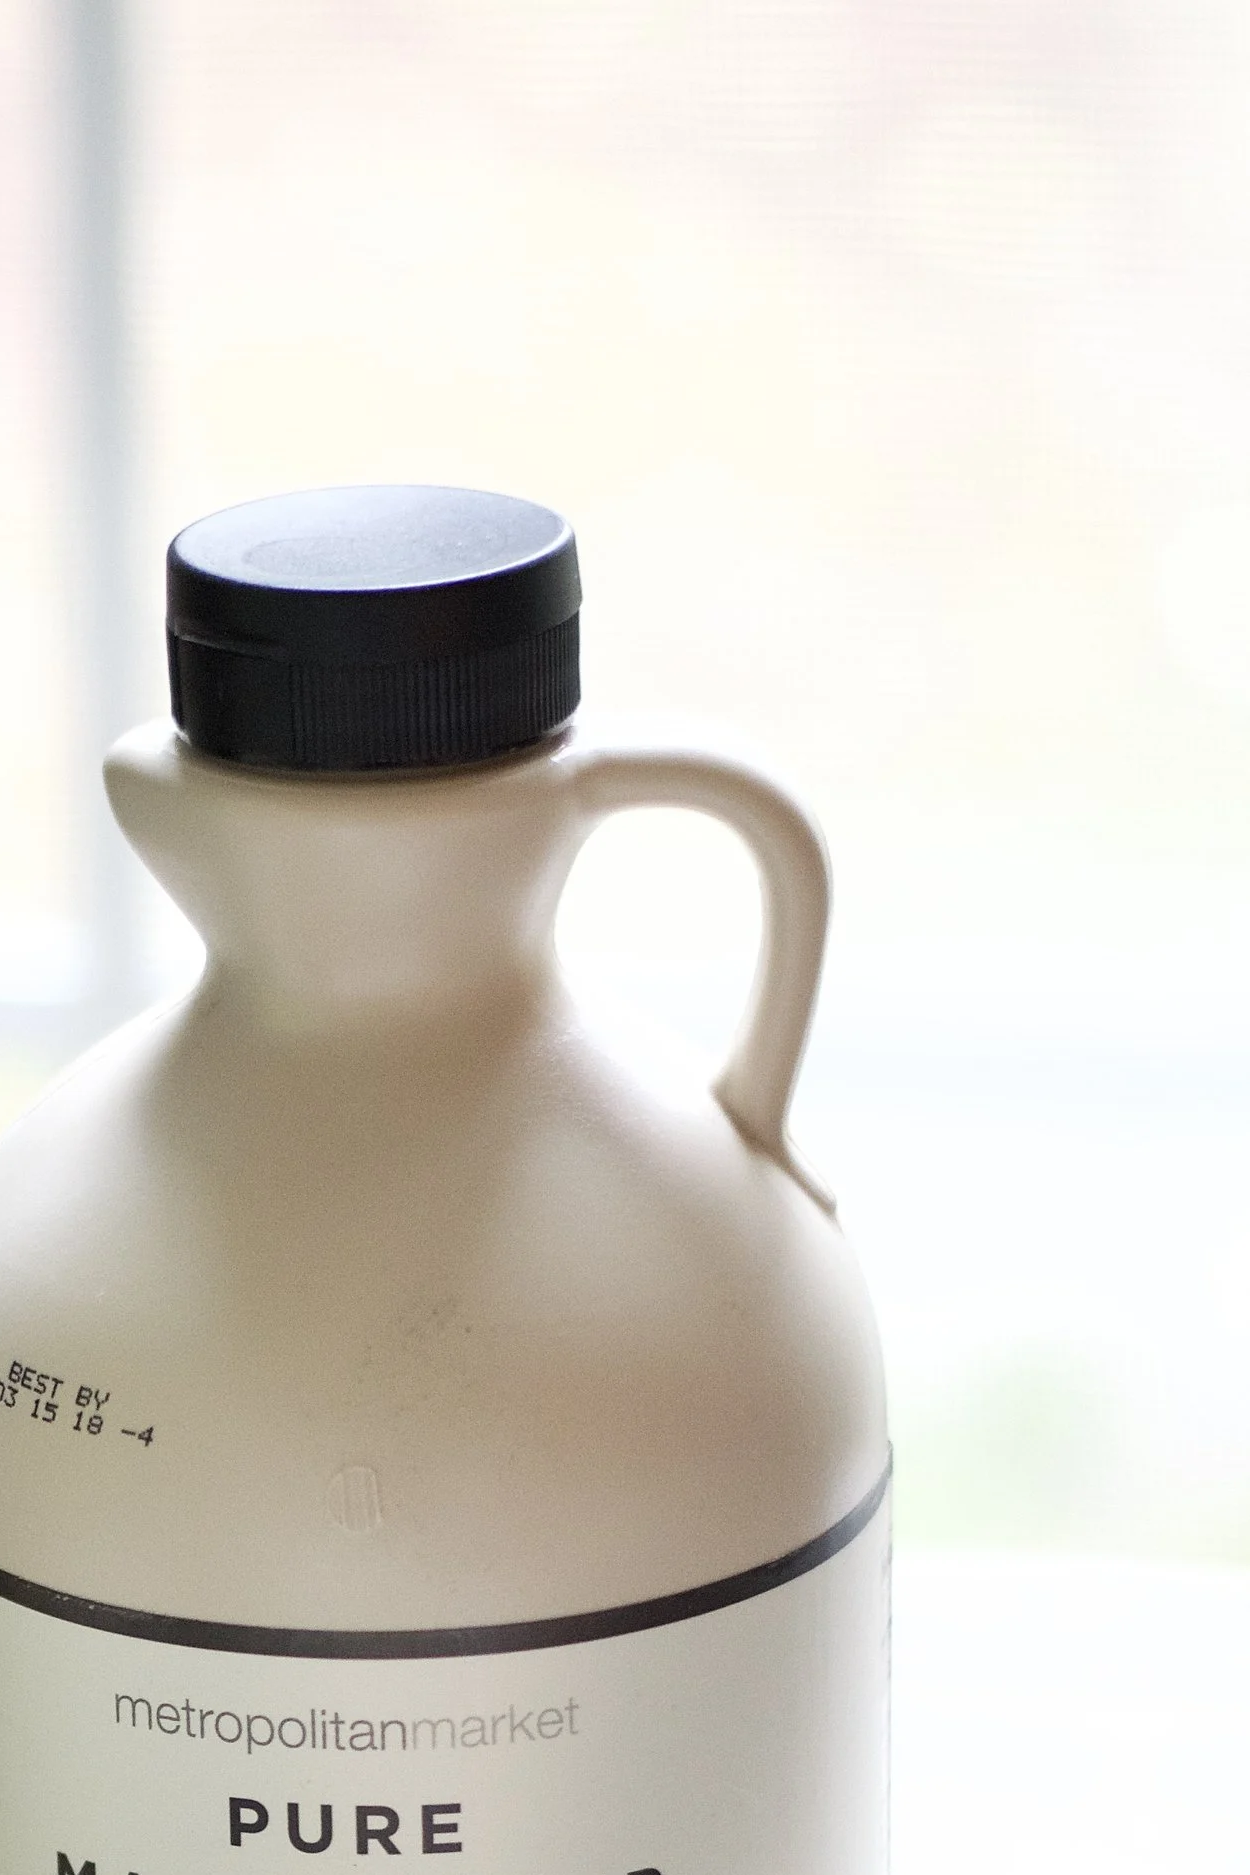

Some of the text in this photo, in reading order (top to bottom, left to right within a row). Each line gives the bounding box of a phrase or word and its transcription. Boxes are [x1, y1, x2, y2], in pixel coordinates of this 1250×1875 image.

[7, 1360, 111, 1411] BEST BY
[30, 1398, 59, 1424] 15
[72, 1411, 104, 1435] 18
[114, 1693, 581, 1755] metropolitanmarket
[228, 1796, 463, 1856] PURE
